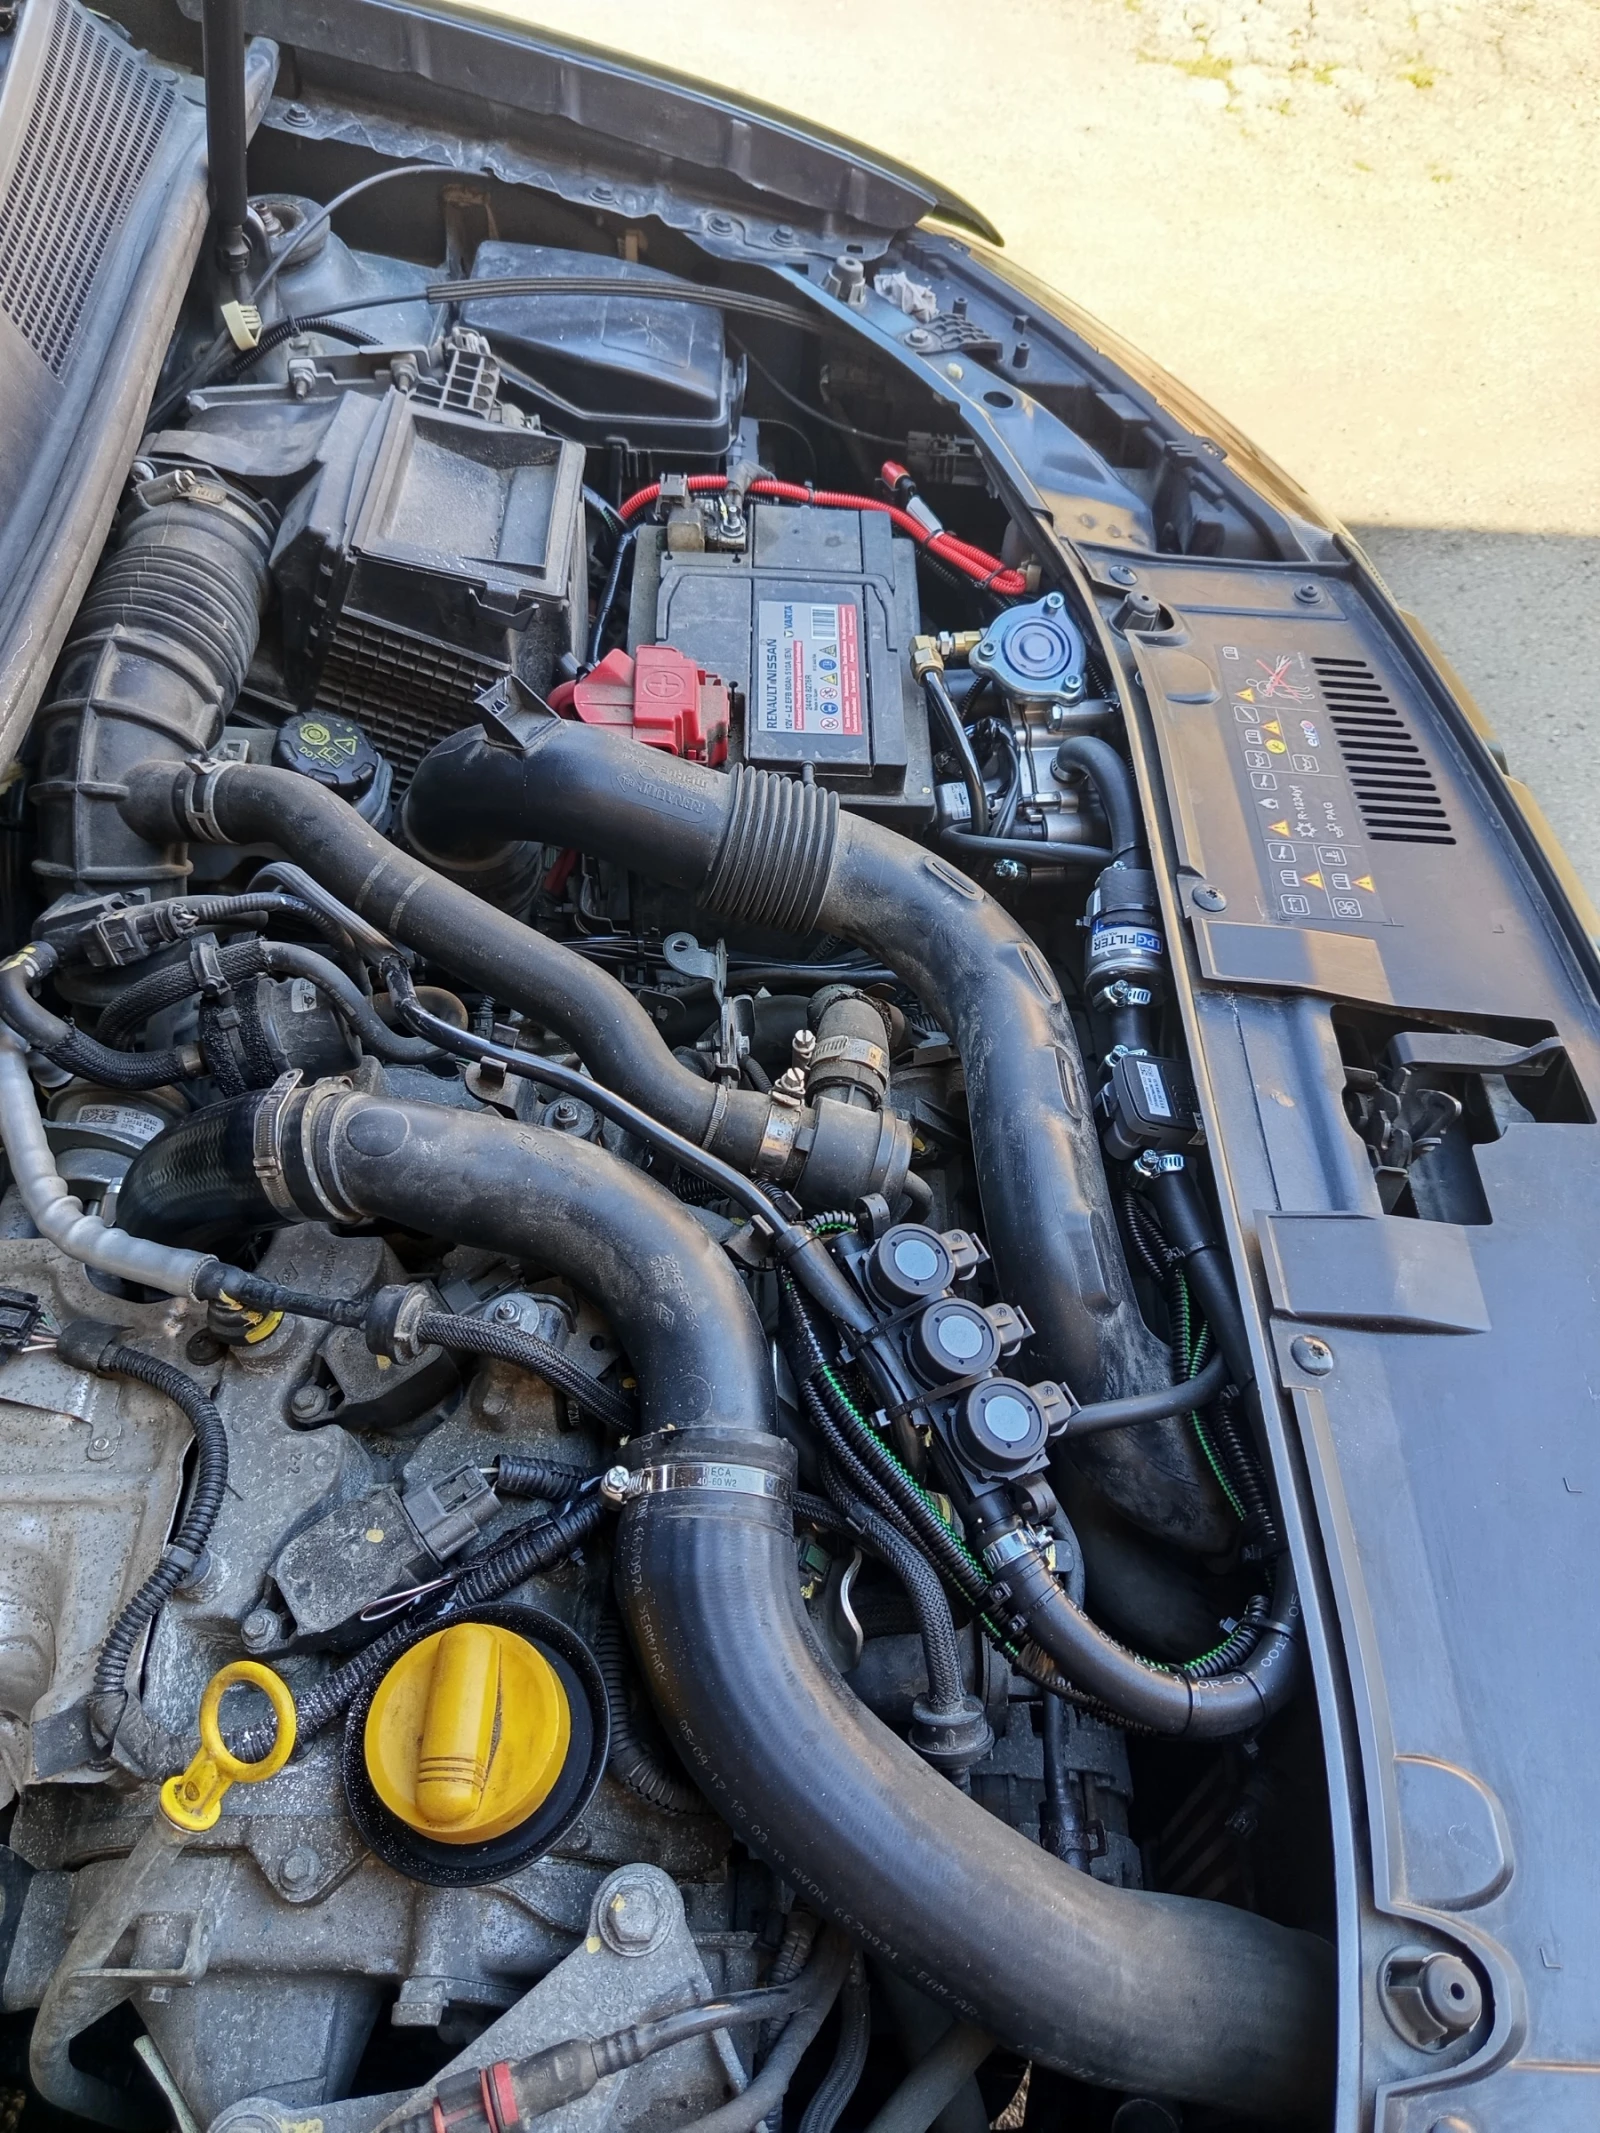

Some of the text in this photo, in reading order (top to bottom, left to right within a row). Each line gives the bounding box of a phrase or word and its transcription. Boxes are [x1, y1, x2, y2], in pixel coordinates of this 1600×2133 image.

[784, 605, 793, 629] VARTA
[784, 661, 793, 675] 510A
[766, 638, 777, 729] RENAULT NISSAN
[784, 676, 793, 691] 60Ah
[784, 692, 793, 704] EFB
[785, 705, 793, 713] L2
[785, 718, 793, 730] 12V
[298, 746, 320, 761] DOT
[637, 781, 706, 815] RENAULT
[1289, 785, 1308, 820] R-1234yf
[1323, 801, 1338, 821] PAG
[1093, 934, 1161, 952] LPG FILTER
[696, 1476, 737, 1488] 40-60 W2
[791, 1866, 829, 1904] AVON
